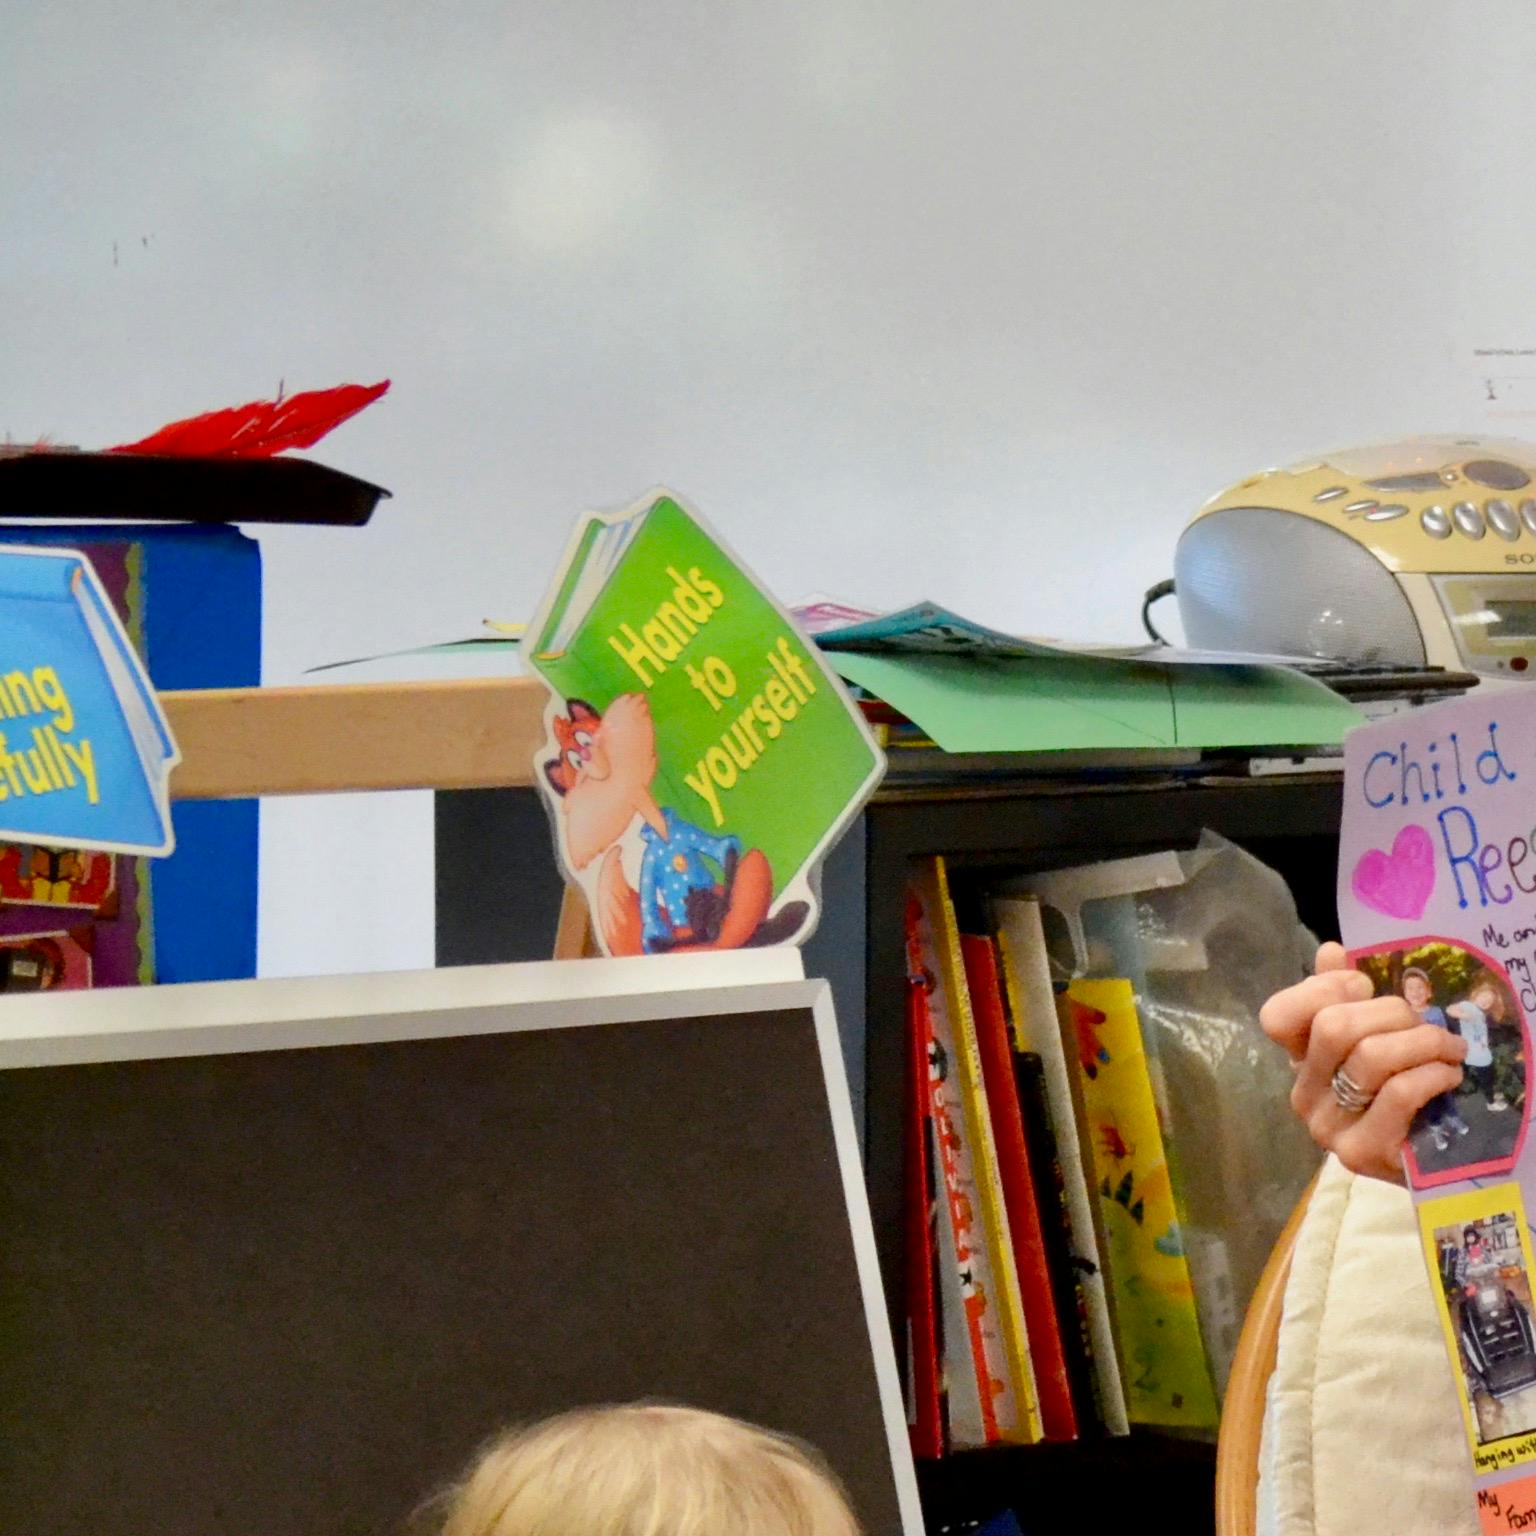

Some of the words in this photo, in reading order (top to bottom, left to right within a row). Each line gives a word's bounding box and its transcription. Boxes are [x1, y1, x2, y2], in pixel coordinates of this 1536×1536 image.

[608, 564, 724, 688] Hands
[684, 655, 736, 712] to
[684, 636, 817, 828] yourself
[1363, 722, 1516, 808] Child
[1481, 923, 1510, 948] Me
[1473, 1448, 1516, 1471] Hanging
[1477, 1489, 1501, 1517] My
